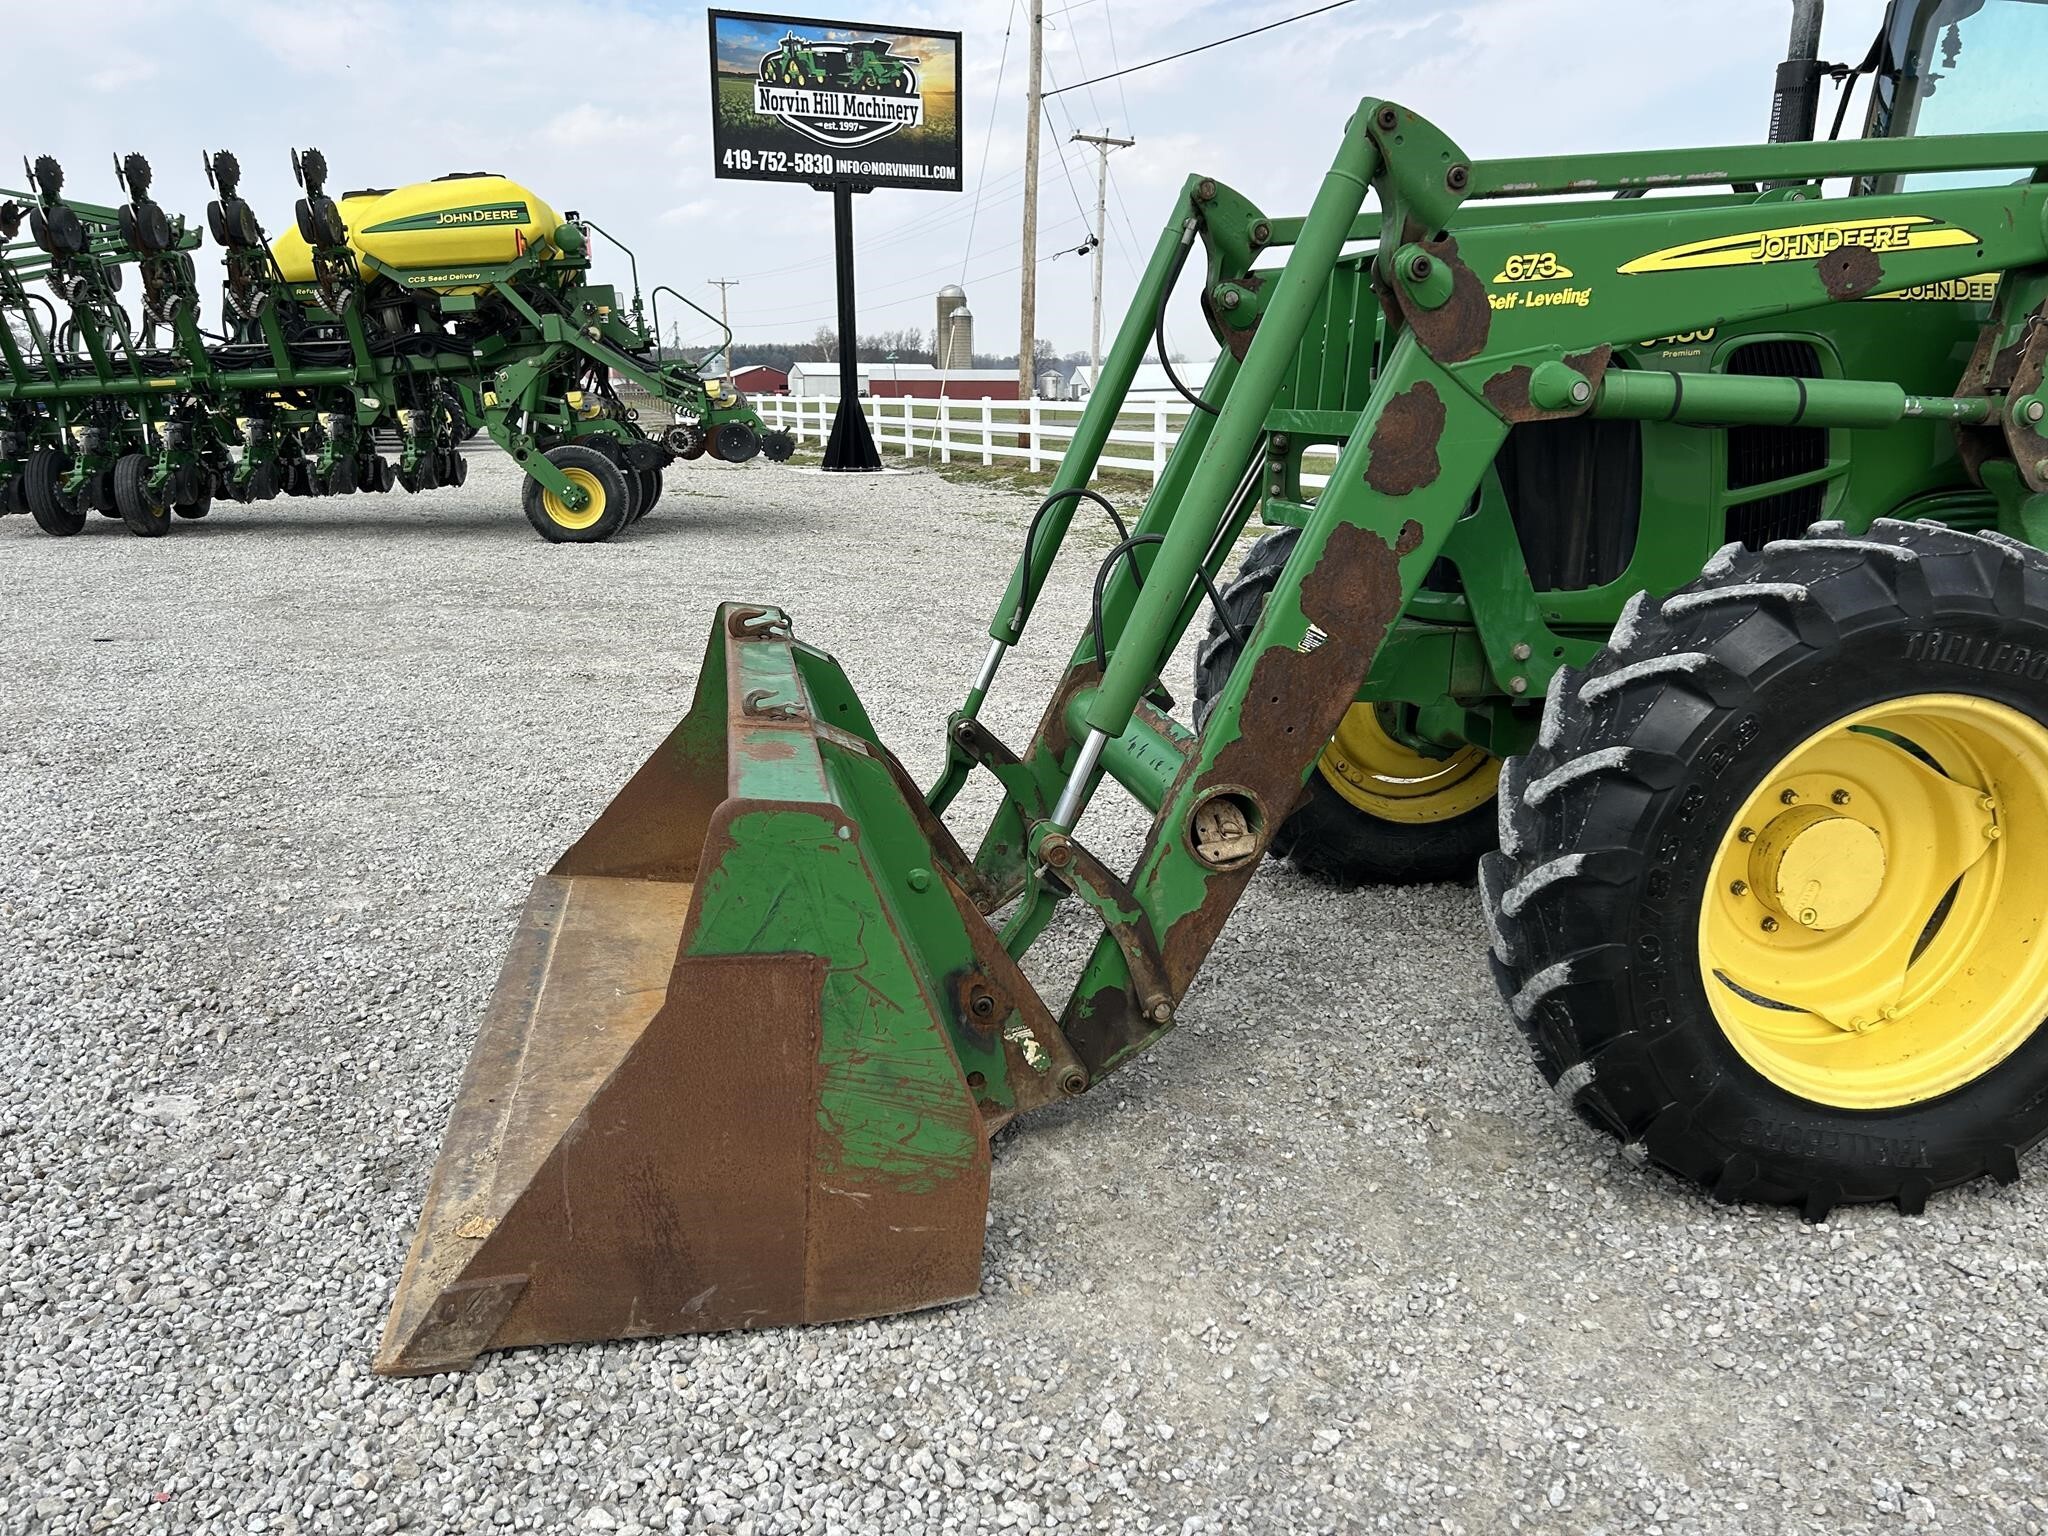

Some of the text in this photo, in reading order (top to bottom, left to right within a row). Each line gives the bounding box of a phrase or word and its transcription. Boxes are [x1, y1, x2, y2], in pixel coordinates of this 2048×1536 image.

[759, 88, 919, 124] Norvin Hill Machinery
[823, 120, 859, 132] est. 1997
[722, 148, 956, 180] 419-752-5830 INFO@NORVINHILL.COM
[436, 210, 519, 225] JOHN DEERE
[1751, 225, 1911, 259] JOHN DEERE
[1505, 251, 1558, 281] 673
[408, 272, 481, 284] CCS Seed Delivery
[1954, 278, 1998, 299] DEE
[1662, 348, 1702, 359] Premium
